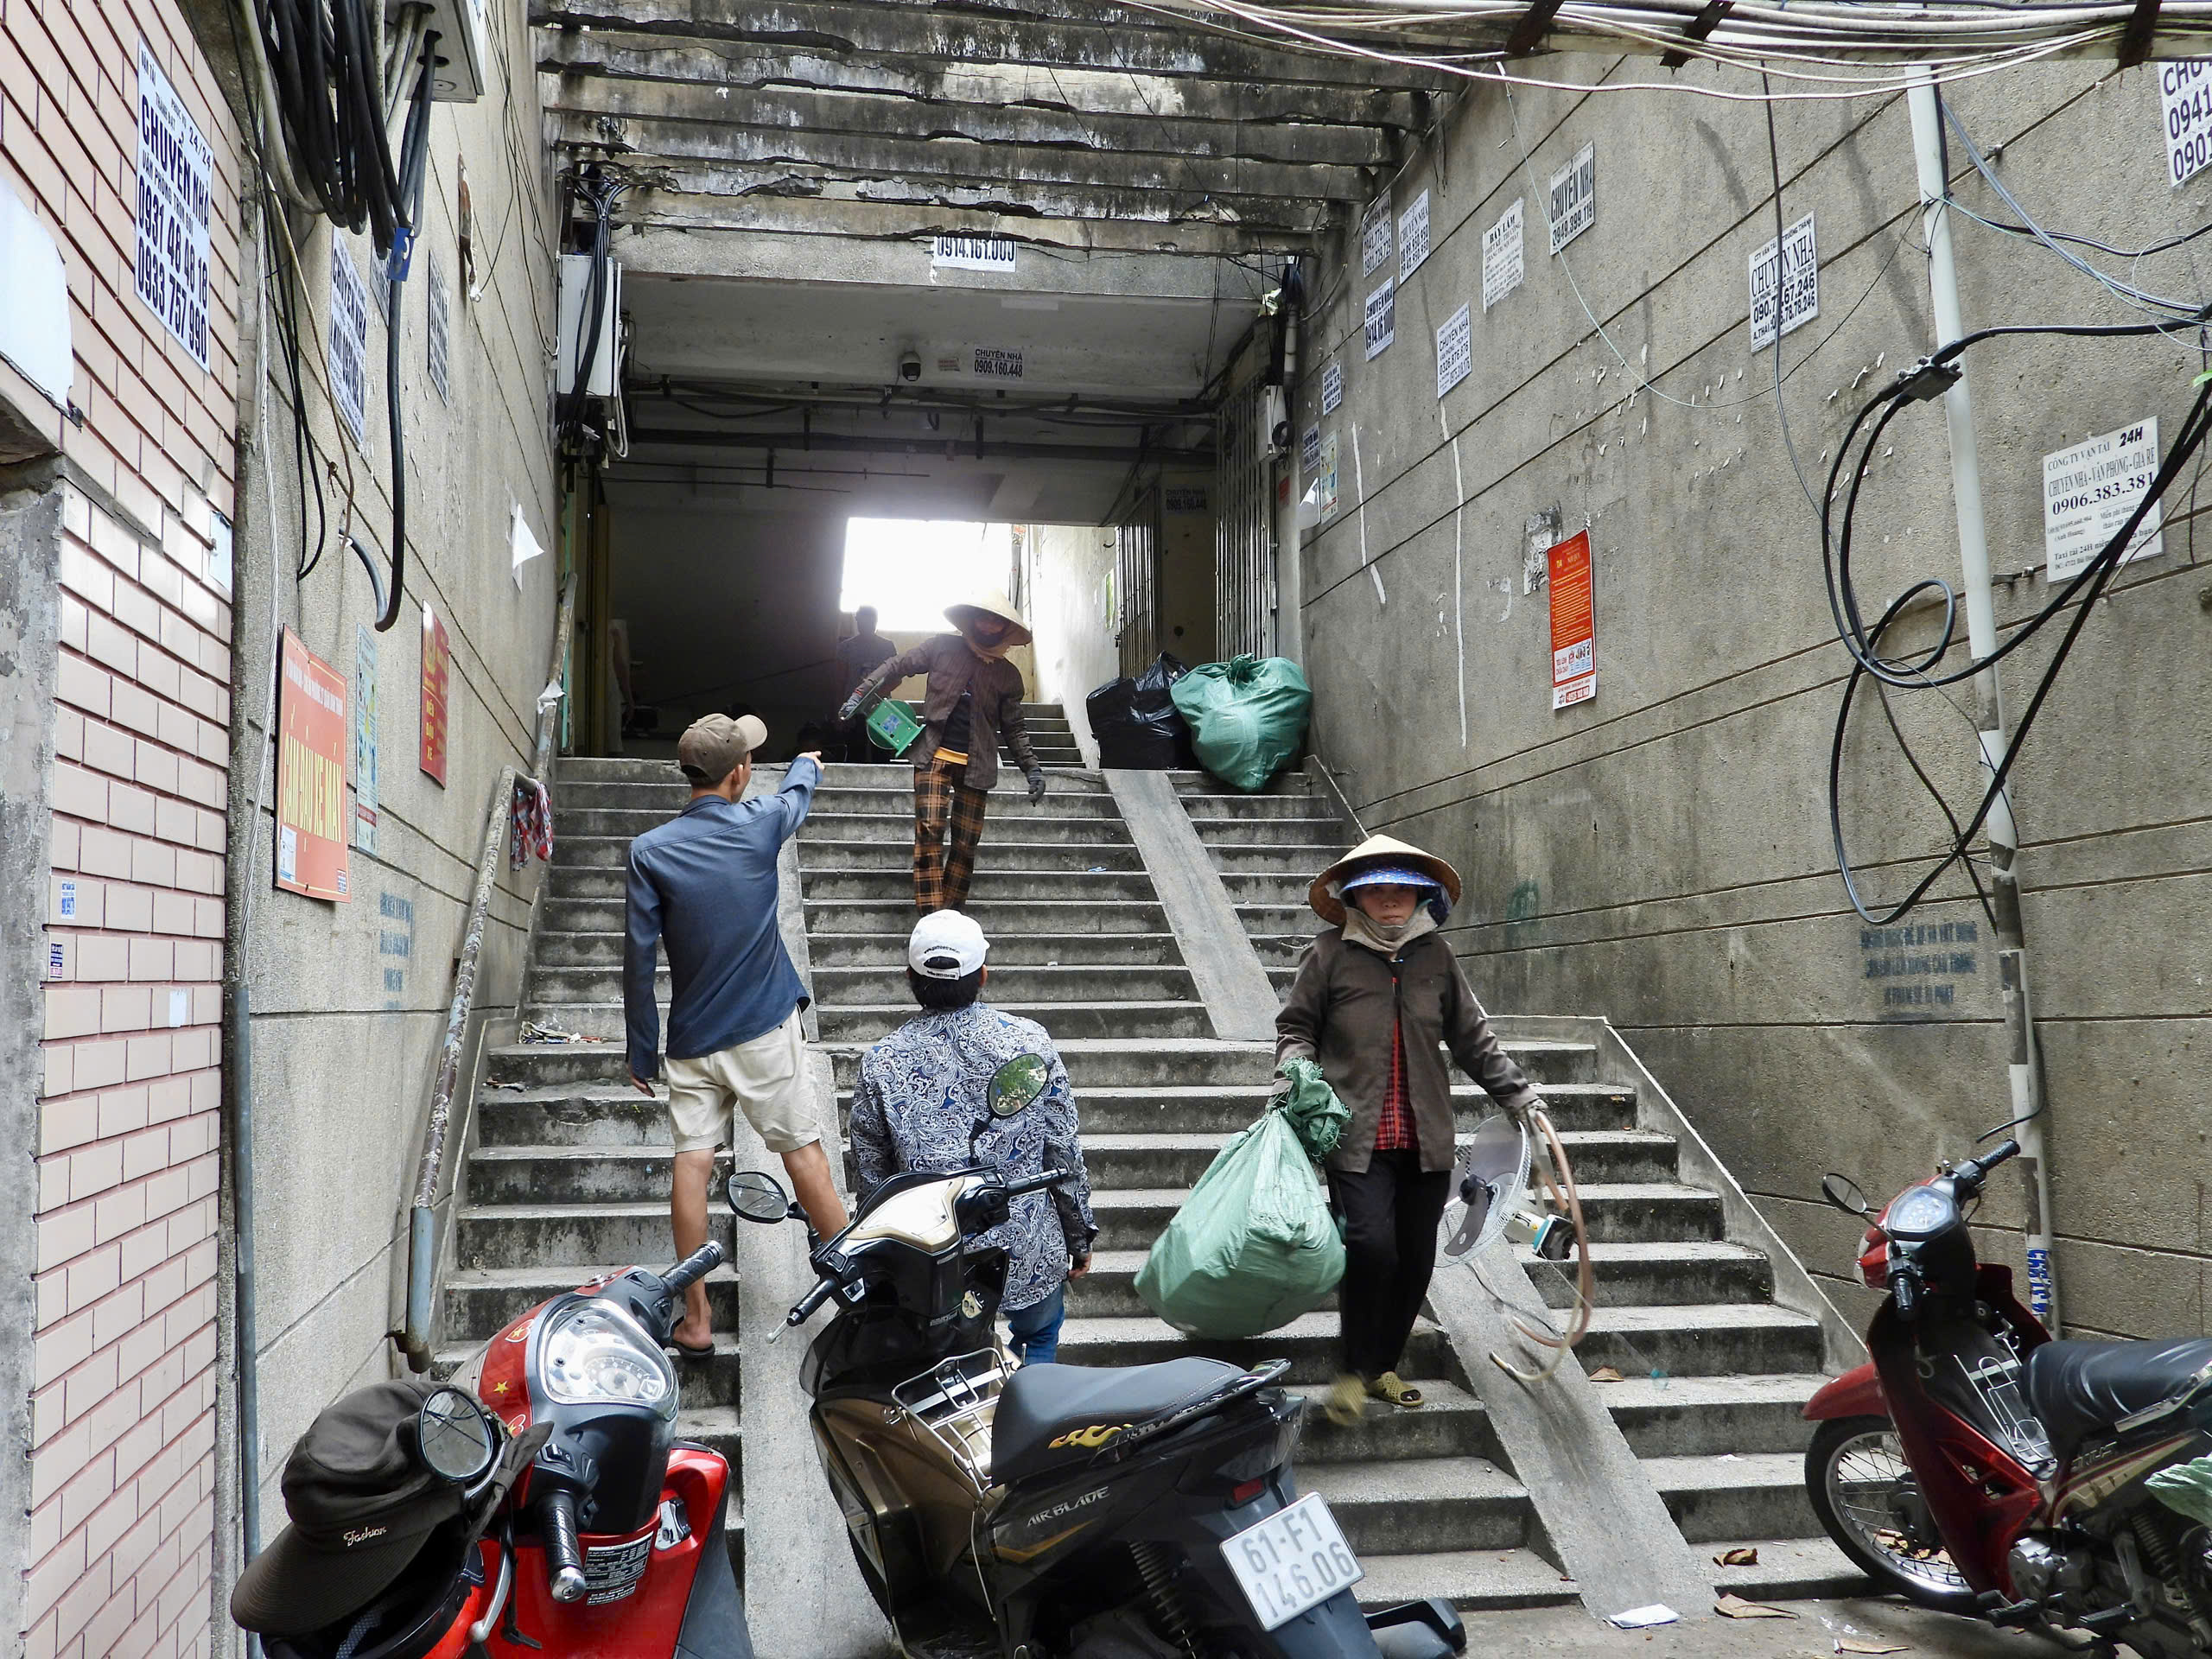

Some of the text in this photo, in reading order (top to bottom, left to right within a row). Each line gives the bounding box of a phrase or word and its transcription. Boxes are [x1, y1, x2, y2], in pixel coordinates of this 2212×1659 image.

[2164, 62, 2212, 96] CHU
[141, 94, 209, 235] CHUYỂN NHÀ
[188, 124, 211, 173] 24/24
[1551, 154, 1578, 224] CHUYỂN
[137, 170, 207, 312] 0931 48 48 18
[1751, 227, 1814, 297] CHUYN NHÀ
[137, 233, 207, 367] 0933 757 990
[1753, 270, 1815, 324] 090.7.67.246
[975, 359, 1023, 378] 0909.160.448
[2048, 453, 2069, 472] CÔNG
[2069, 451, 2079, 463] TY
[2119, 425, 2143, 448] 24H
[2048, 471, 2074, 498] CHUYỂN
[2052, 470, 2153, 516] 0906.383.381
[2055, 550, 2067, 560] Taxi
[314, 750, 323, 837] XE
[325, 734, 342, 845] MÁY
[1027, 1486, 1110, 1528] AIR BLADE
[343, 1526, 387, 1547] Fashion
[1255, 1541, 1354, 1618] 146.06
